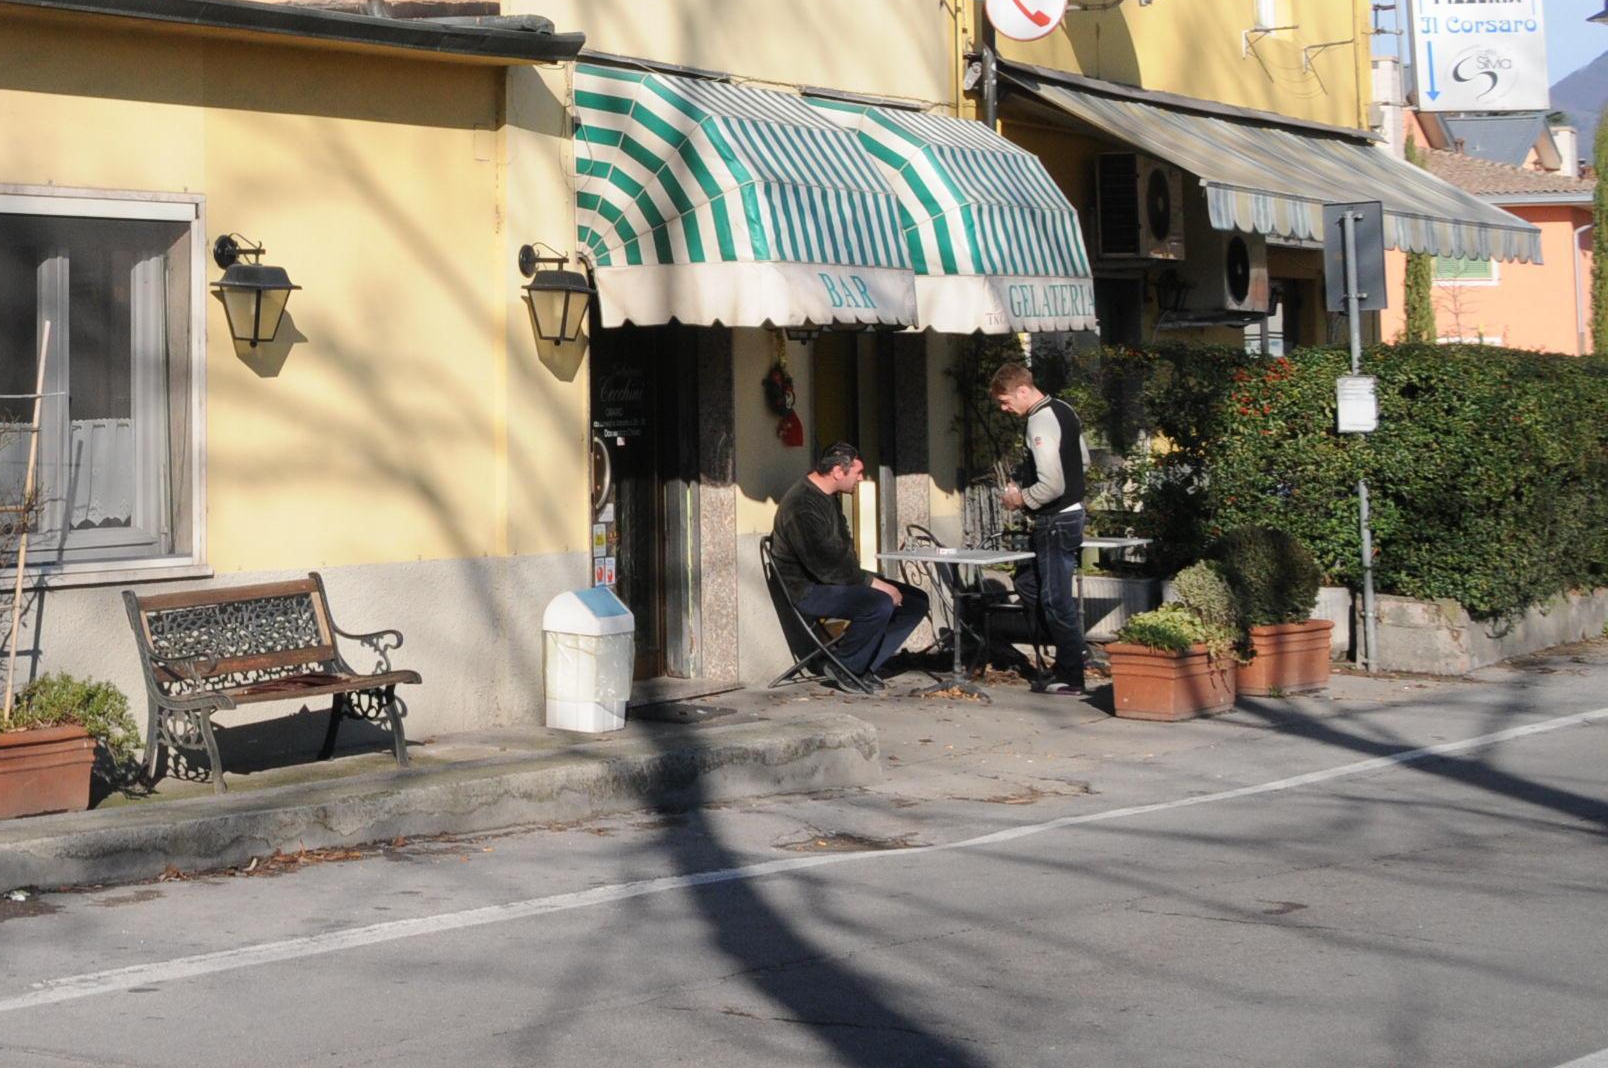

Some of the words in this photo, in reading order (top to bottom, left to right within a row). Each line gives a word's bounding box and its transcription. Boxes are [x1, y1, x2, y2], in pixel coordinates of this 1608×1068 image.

[1420, 16, 1438, 34] Il
[1446, 17, 1537, 33] Corsaro
[818, 272, 878, 309] BAR
